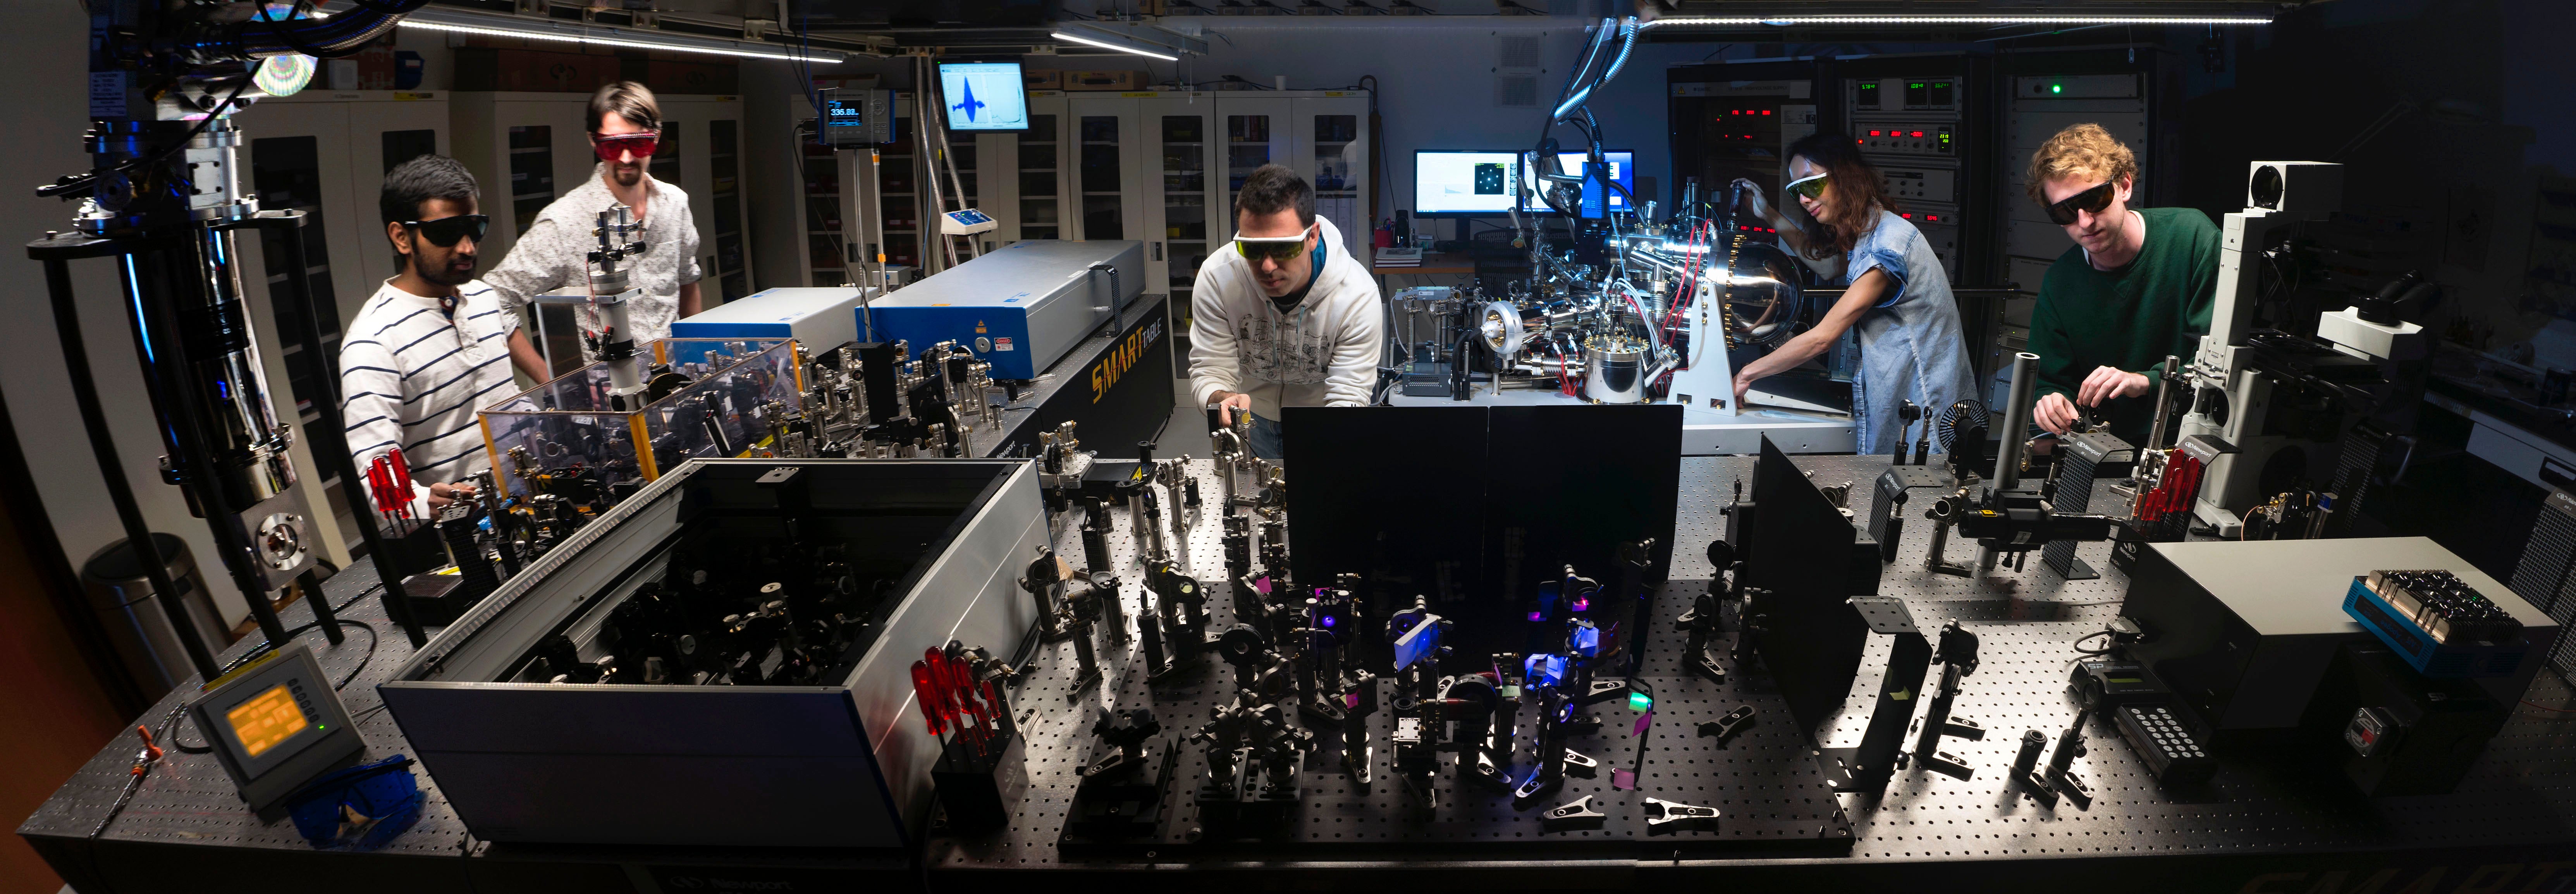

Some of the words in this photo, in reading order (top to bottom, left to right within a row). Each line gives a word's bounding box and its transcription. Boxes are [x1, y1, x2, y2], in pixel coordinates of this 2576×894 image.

[1092, 325, 1143, 405] SMART
[1142, 317, 1161, 349] TABLE
[996, 440, 1016, 458] Newport
[2084, 445, 2101, 457] Newport
[2192, 446, 2212, 458] Newport
[1890, 477, 1901, 491] Newport
[2119, 546, 2136, 562] Newport
[710, 877, 794, 892] Newport
